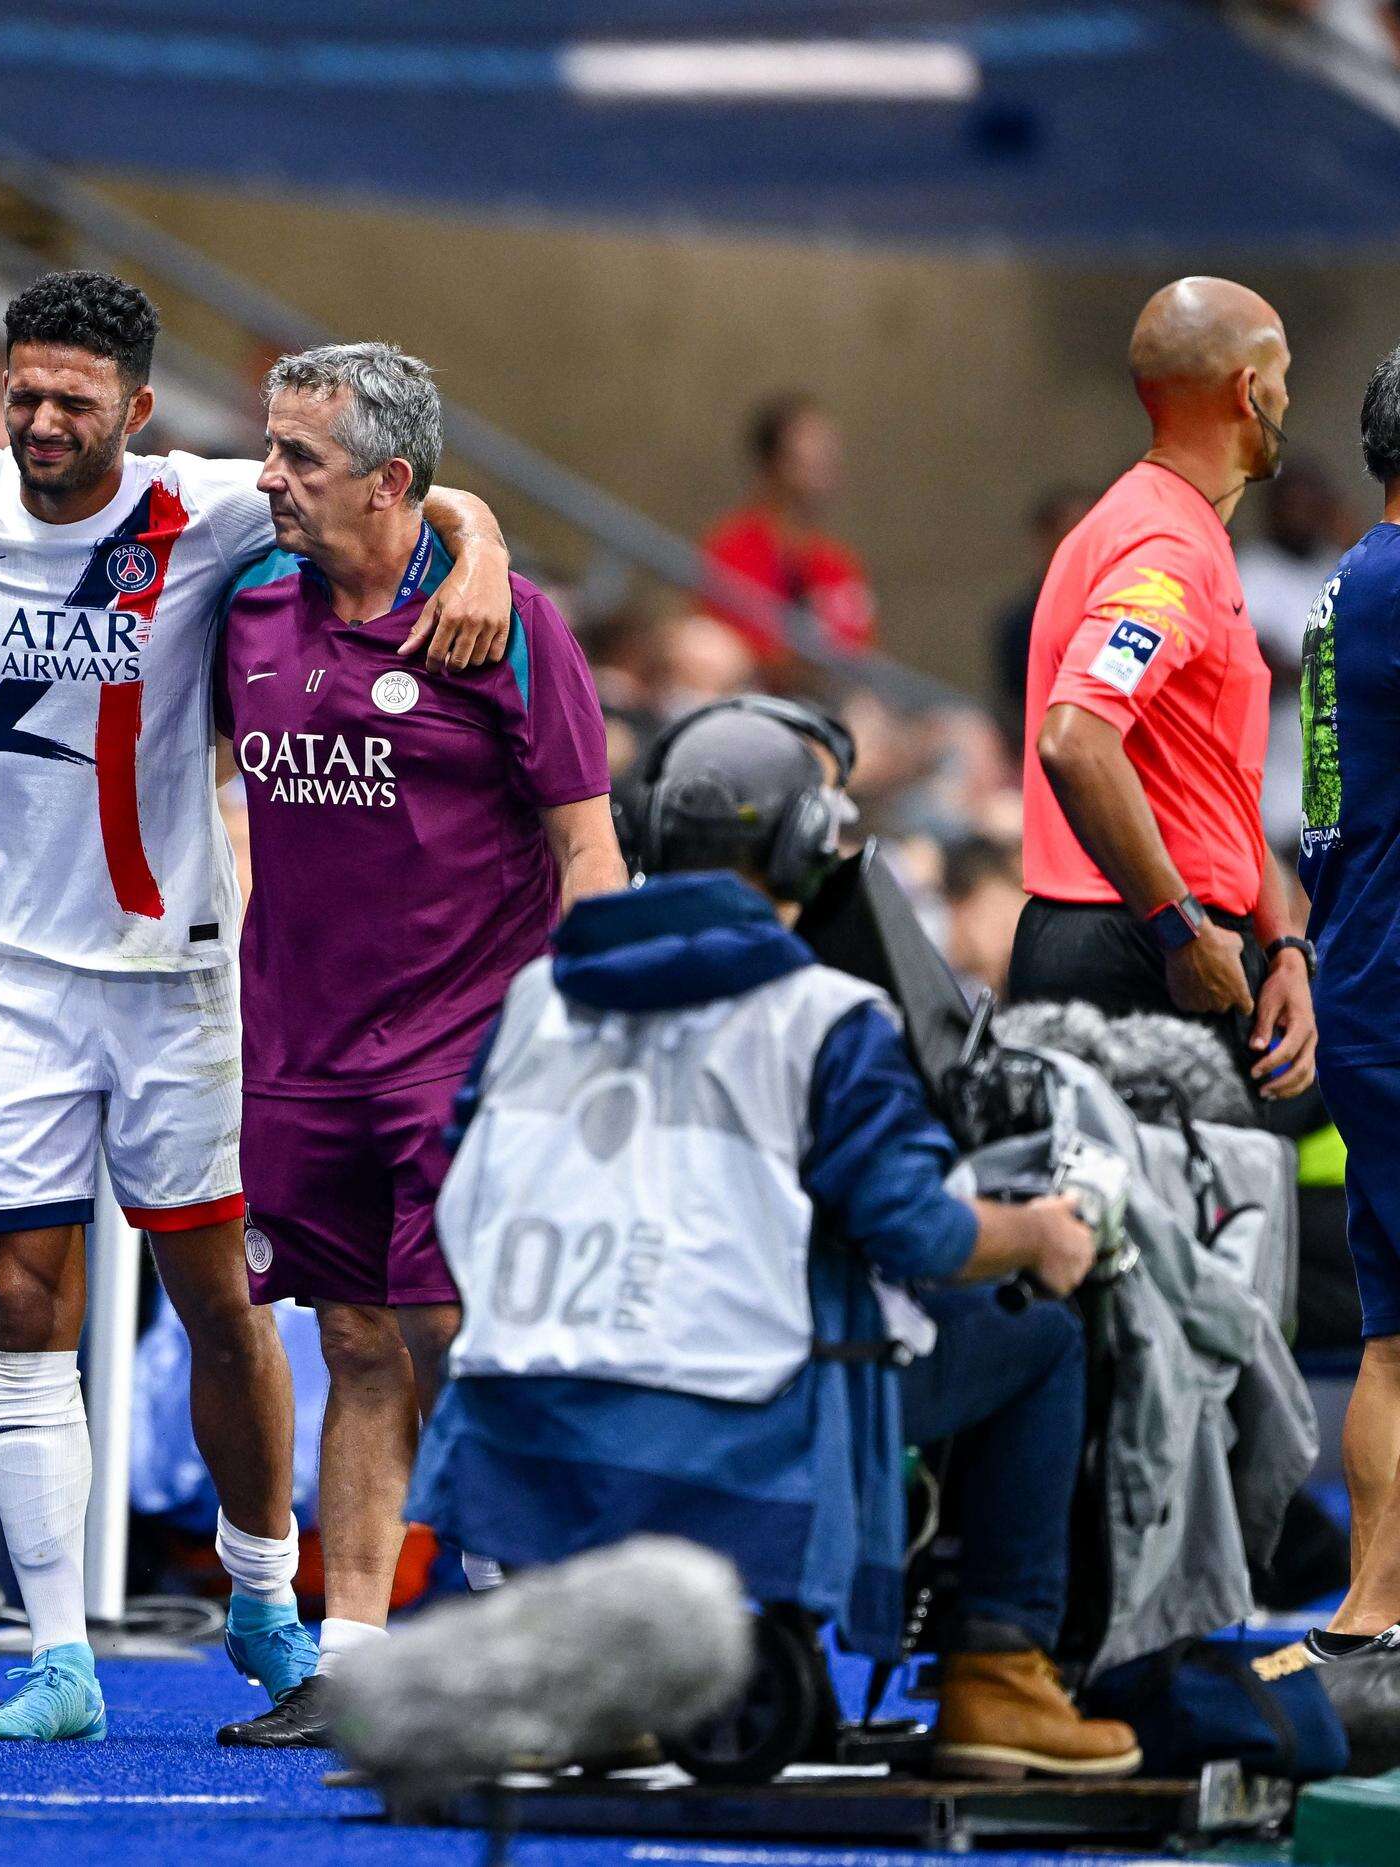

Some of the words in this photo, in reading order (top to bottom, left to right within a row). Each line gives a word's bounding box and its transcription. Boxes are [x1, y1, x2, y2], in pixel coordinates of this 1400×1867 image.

[114, 546, 147, 559] PARIS
[408, 562, 421, 581] UEFA
[1118, 626, 1153, 650] LFP
[0, 651, 140, 684] AIRWAYS
[305, 669, 326, 692] LT
[385, 678, 410, 687] PARIS
[240, 730, 396, 783] QATAR
[270, 777, 396, 808] AIRWAYS
[492, 1217, 617, 1327] 02
